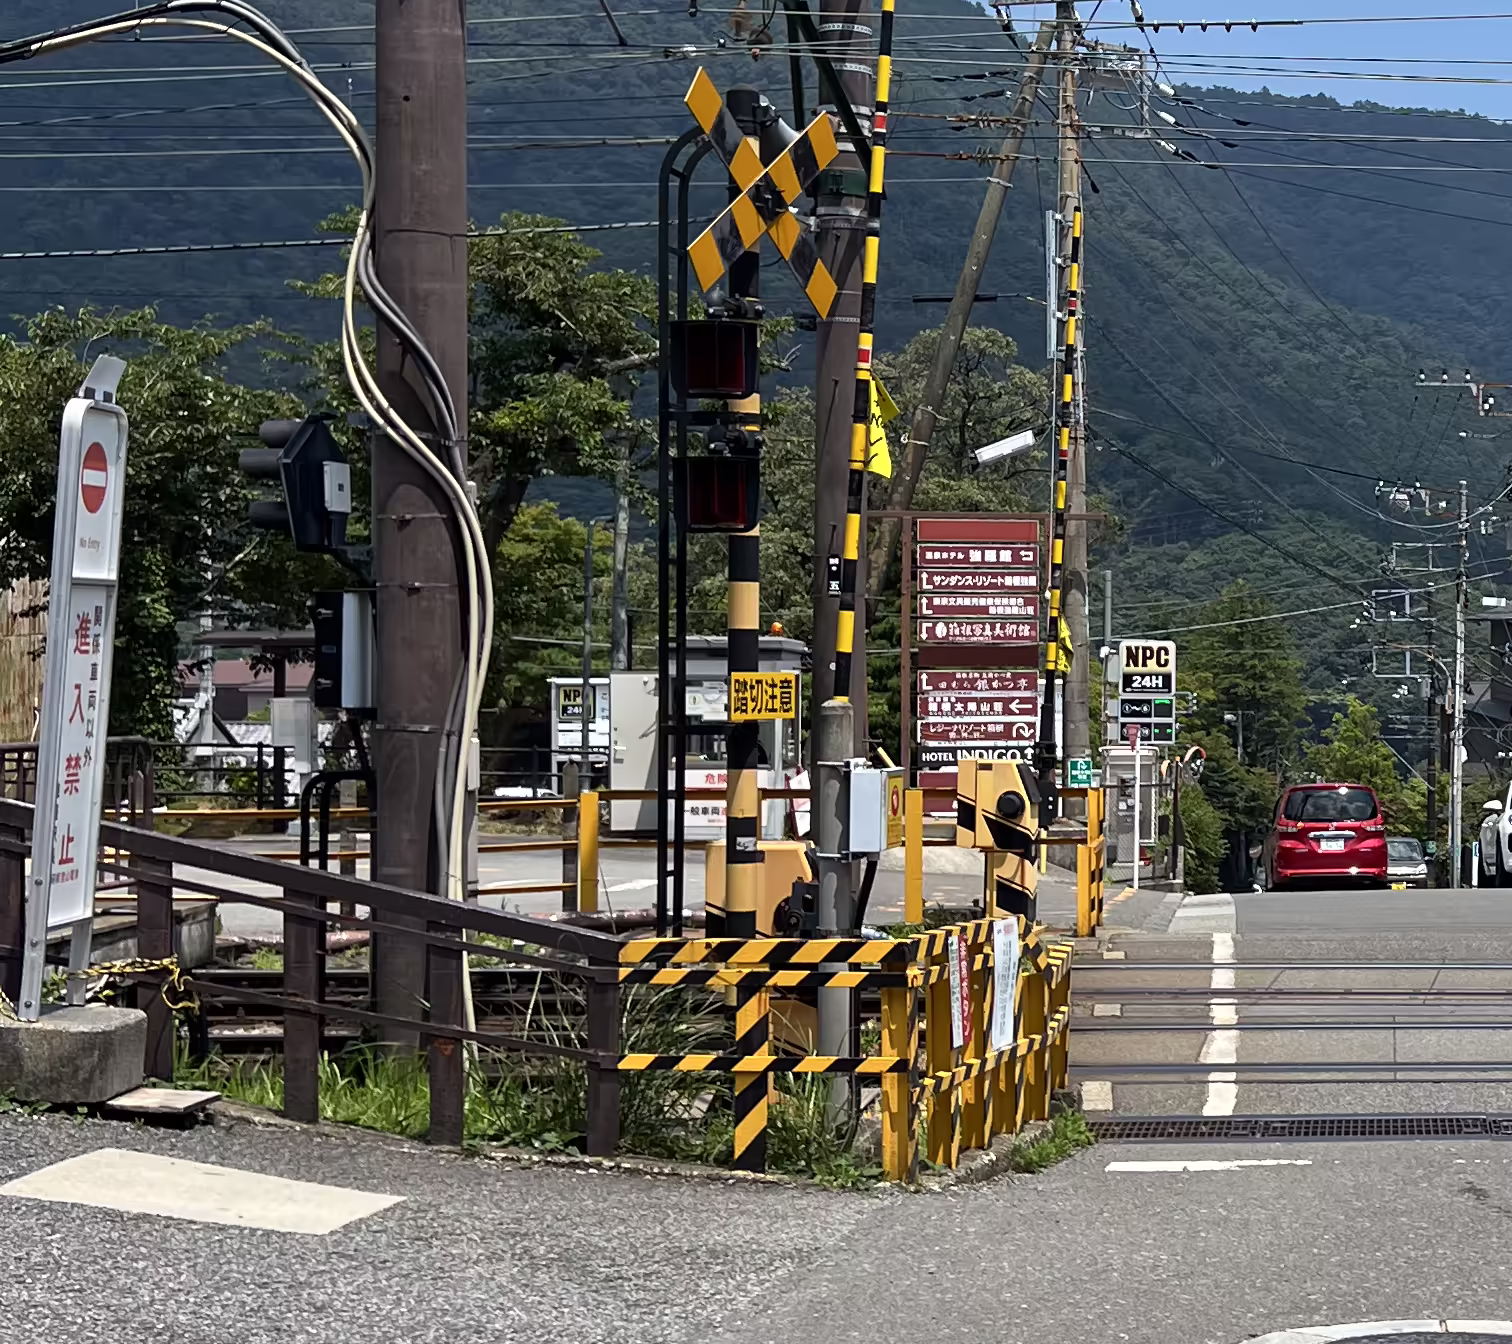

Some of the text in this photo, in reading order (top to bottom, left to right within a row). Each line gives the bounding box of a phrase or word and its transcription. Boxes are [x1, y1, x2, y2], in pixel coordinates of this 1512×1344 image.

[1125, 645, 1169, 668] NPC
[1131, 675, 1163, 688] 24H
[734, 677, 793, 715] 踏切注意
[58, 611, 92, 865] 進入禁止
[922, 749, 1021, 762] HOTEL INDIGO
